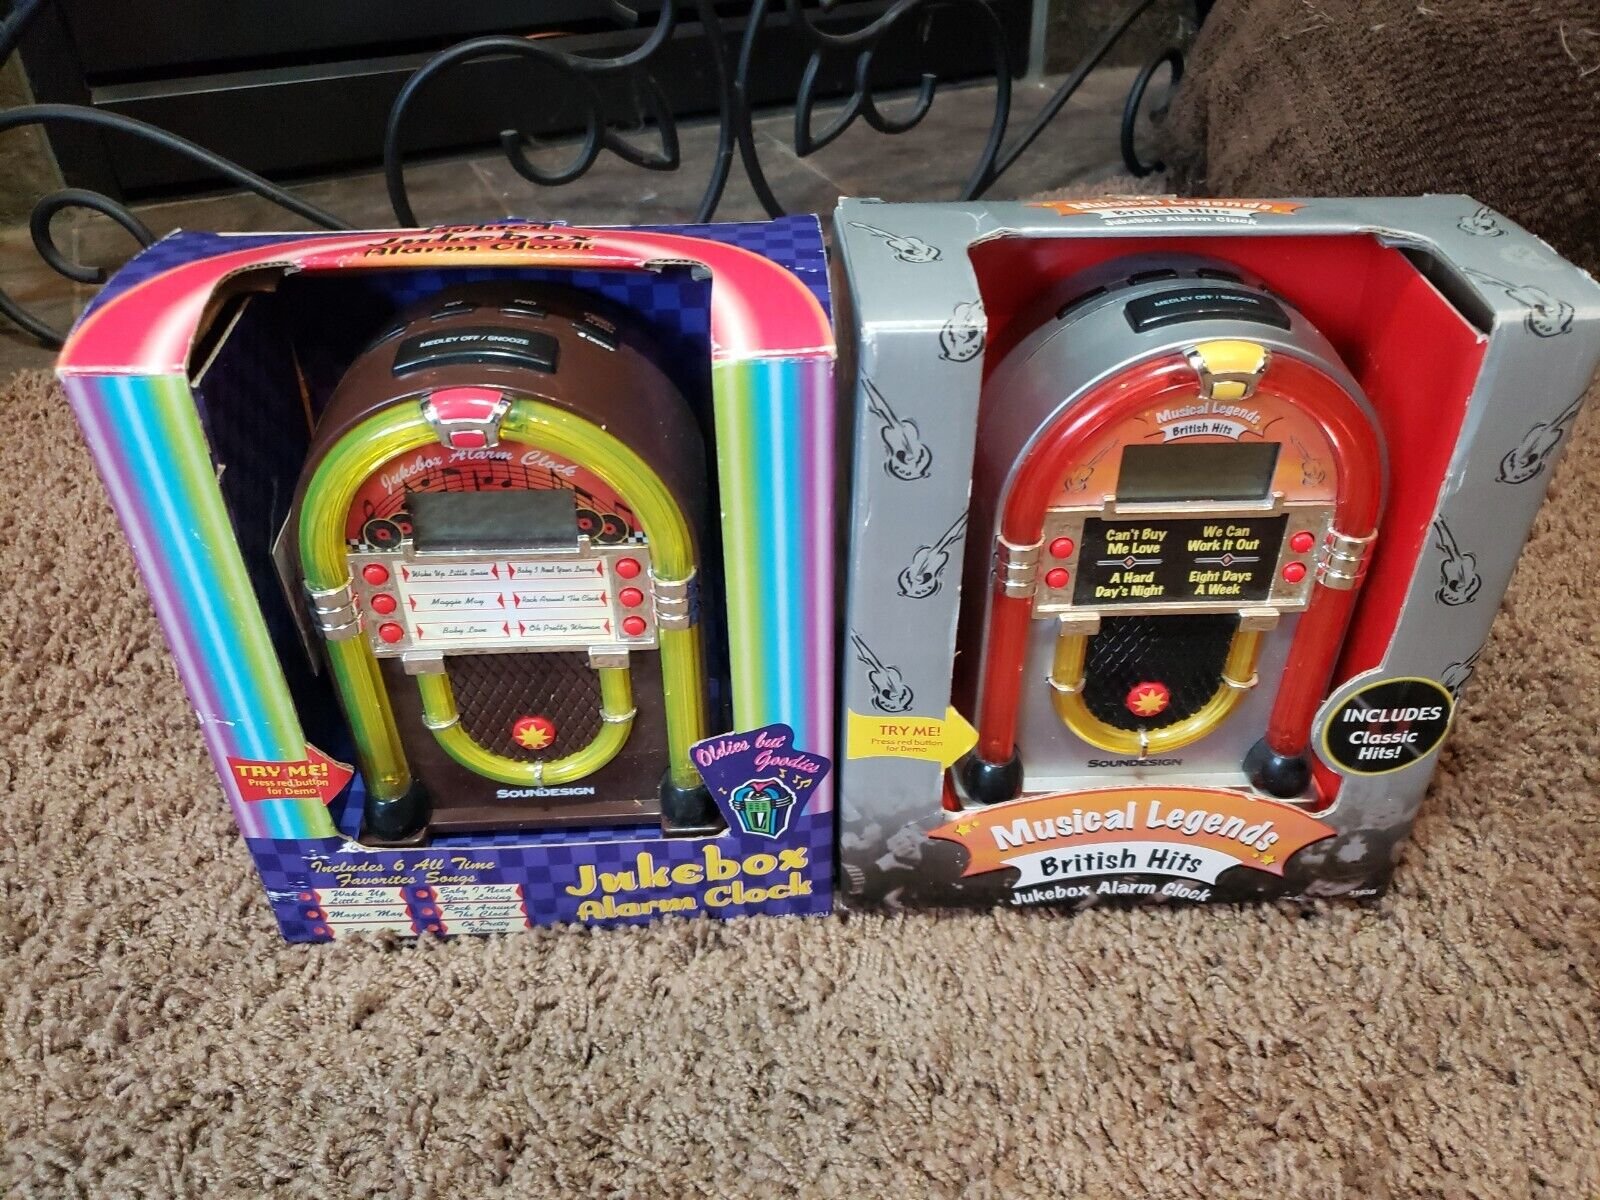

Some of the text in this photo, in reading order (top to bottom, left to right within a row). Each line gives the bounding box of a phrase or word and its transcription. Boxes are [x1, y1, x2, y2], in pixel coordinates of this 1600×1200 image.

[1066, 200, 1272, 210] Musical Legends
[1111, 208, 1181, 216] British
[1104, 216, 1163, 226] Jukebox
[1216, 216, 1258, 225] Clock
[369, 231, 594, 247] Jukebox
[364, 240, 596, 258] Alarm Clock
[419, 336, 459, 348] MEDLEY
[486, 335, 530, 346] SNOOZE
[1156, 402, 1261, 424] Musical Legends
[1172, 423, 1232, 436] British Hits
[381, 449, 579, 495] Jukebox Alarm Clock
[1105, 528, 1168, 542] Can't Buy
[1203, 525, 1250, 537] We Can
[1107, 542, 1161, 555] Me Love
[1187, 539, 1260, 551] Work It Out
[1109, 571, 1155, 584] A Hard
[1189, 571, 1252, 583] Eight Days
[1095, 584, 1165, 599] Day's Night
[1194, 584, 1241, 595] A Week
[431, 597, 485, 607] Maggie May
[442, 626, 464, 636] Baby
[1343, 706, 1443, 723] INCLUDES
[879, 725, 941, 737] TRY ME!
[1349, 730, 1418, 745] Classic
[696, 731, 787, 767] Oldies but
[900, 745, 927, 753] Demo
[1358, 745, 1402, 760] Hits!
[754, 749, 820, 773] Goodies
[1087, 758, 1183, 768] SOUNDESIGN
[235, 763, 329, 777] TRY ME!
[248, 778, 329, 788] Press red button
[267, 787, 317, 795] for Demo
[496, 787, 596, 798] SOUNDESIGN
[990, 800, 1280, 852] Musical Legends
[311, 857, 496, 873] Includes 6 All Time
[1039, 848, 1203, 877] British Hits
[565, 844, 809, 896] Jukebox
[335, 871, 478, 887] Favorites Songs
[330, 889, 386, 898] Wake Up
[440, 886, 467, 895] Baby
[576, 871, 813, 921] Alarm Clock
[1010, 880, 1212, 905] Jukebox Alarm Clock
[329, 896, 394, 905] Little Susie
[443, 893, 512, 903] Your Loving
[328, 909, 404, 919] Maggie May
[443, 903, 518, 912] Rock Around
[461, 920, 510, 928] Oh Pretty
